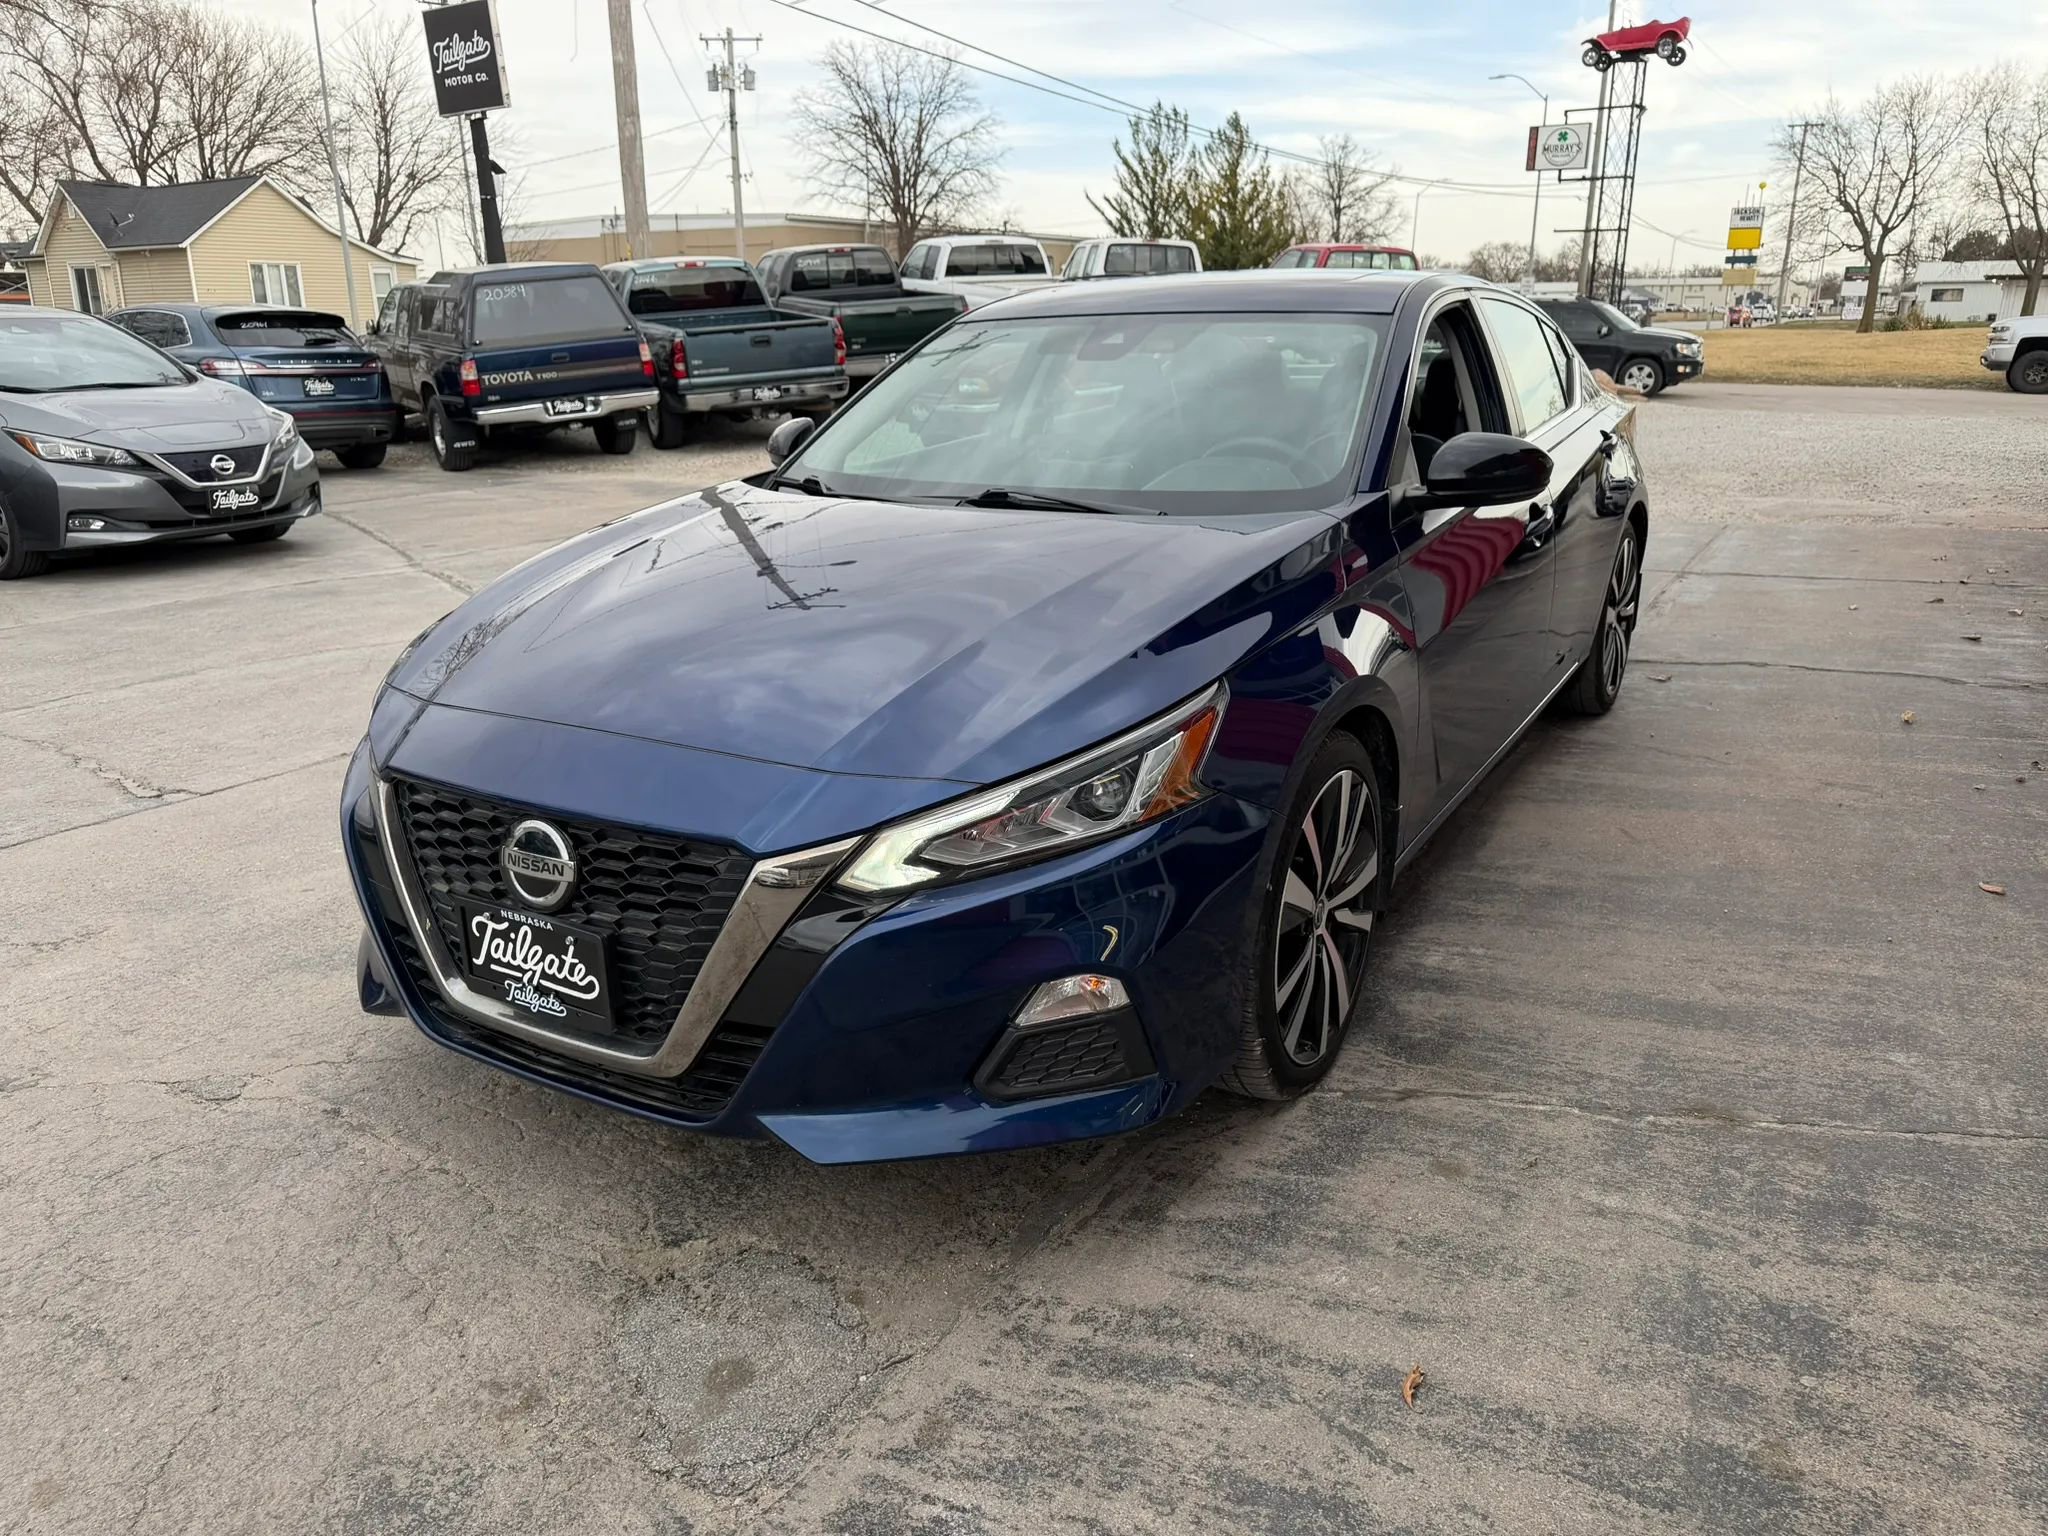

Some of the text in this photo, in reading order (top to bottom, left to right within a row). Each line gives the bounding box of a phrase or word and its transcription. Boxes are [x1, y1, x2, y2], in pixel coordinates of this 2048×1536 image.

[433, 30, 490, 73] Tailgate
[445, 75, 472, 87] MOTOR
[482, 370, 558, 386] TOYOTA T100
[212, 487, 259, 510] Tailgate
[507, 852, 565, 877] NISSAN
[500, 909, 554, 931] NEBRASKA
[472, 915, 600, 999] Tailgate
[504, 979, 567, 1017] Tailgate
